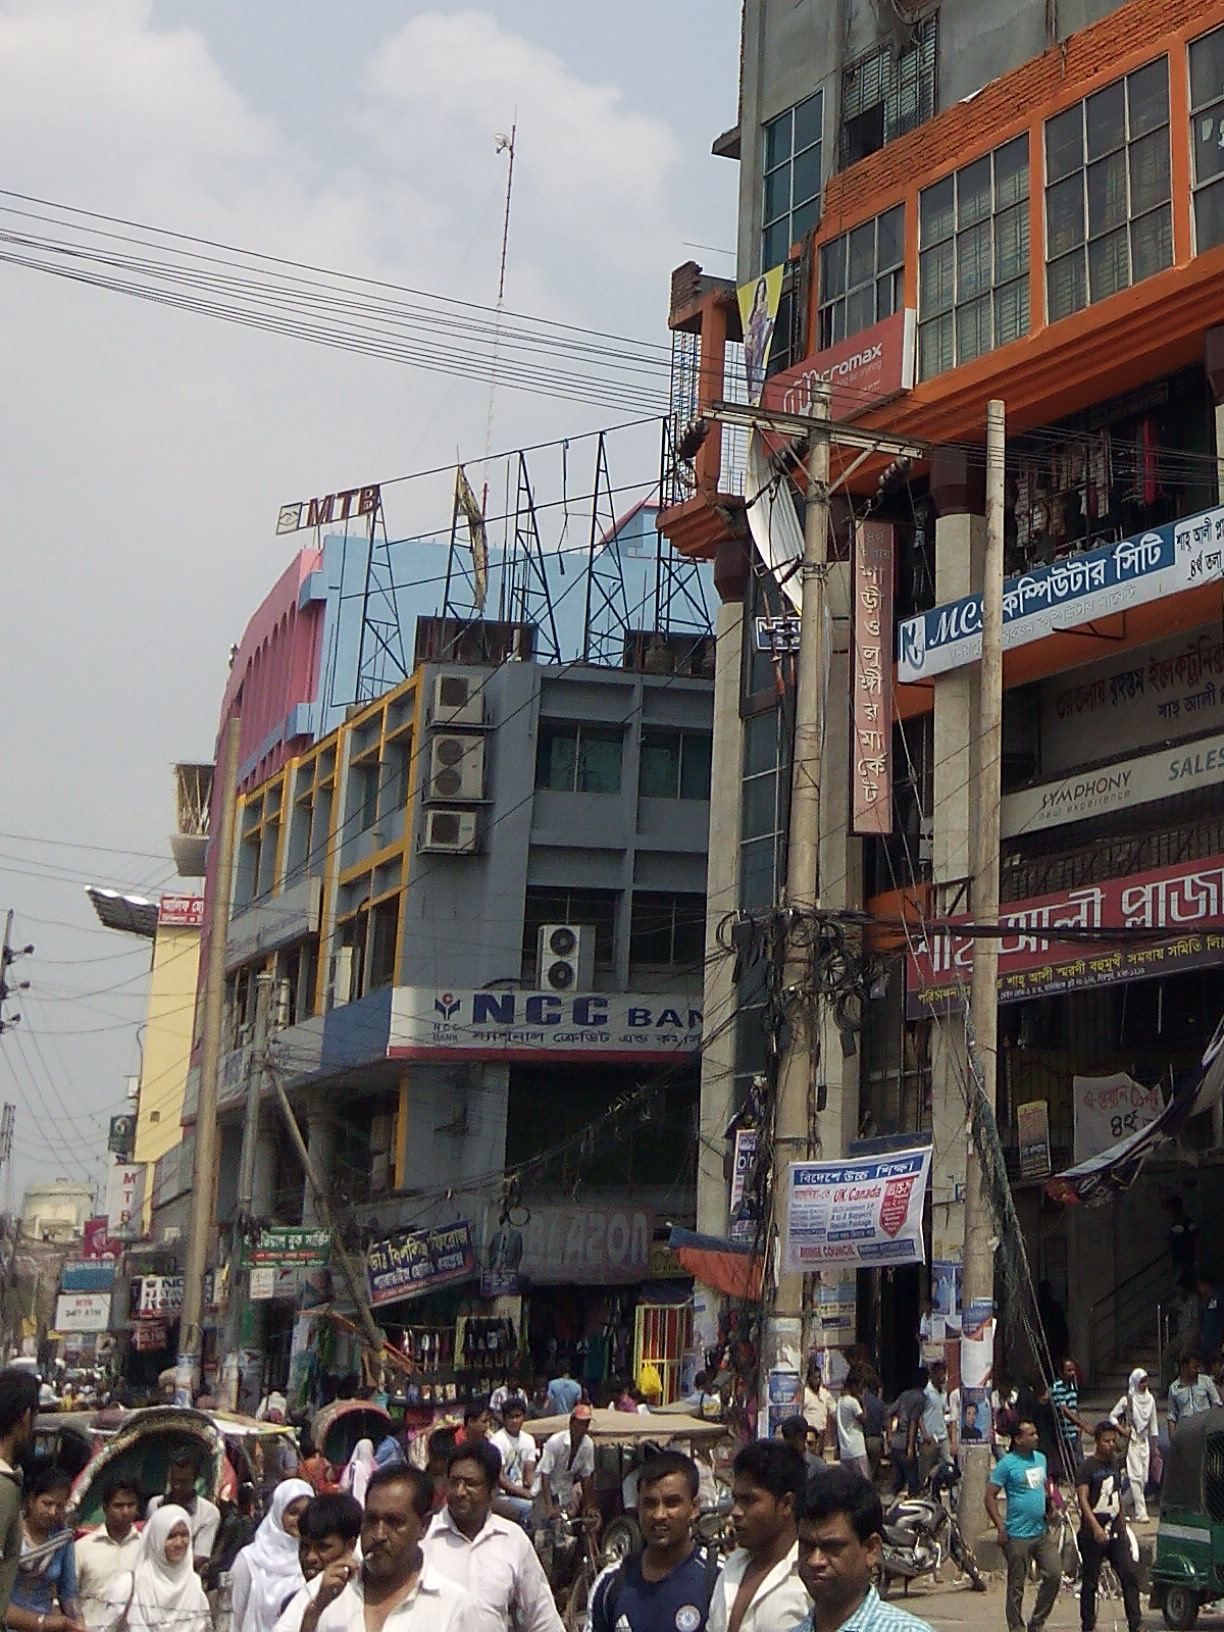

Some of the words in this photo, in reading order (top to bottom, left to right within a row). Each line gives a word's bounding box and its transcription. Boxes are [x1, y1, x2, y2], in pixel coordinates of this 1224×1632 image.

[306, 484, 380, 528] MTB
[1112, 532, 1164, 580] সিটি
[1041, 769, 1132, 809] SYMPHONY
[472, 993, 609, 1026] NCC
[627, 1008, 703, 1028] BAN
[833, 1187, 848, 1203] UK
[848, 1184, 882, 1202] Canada
